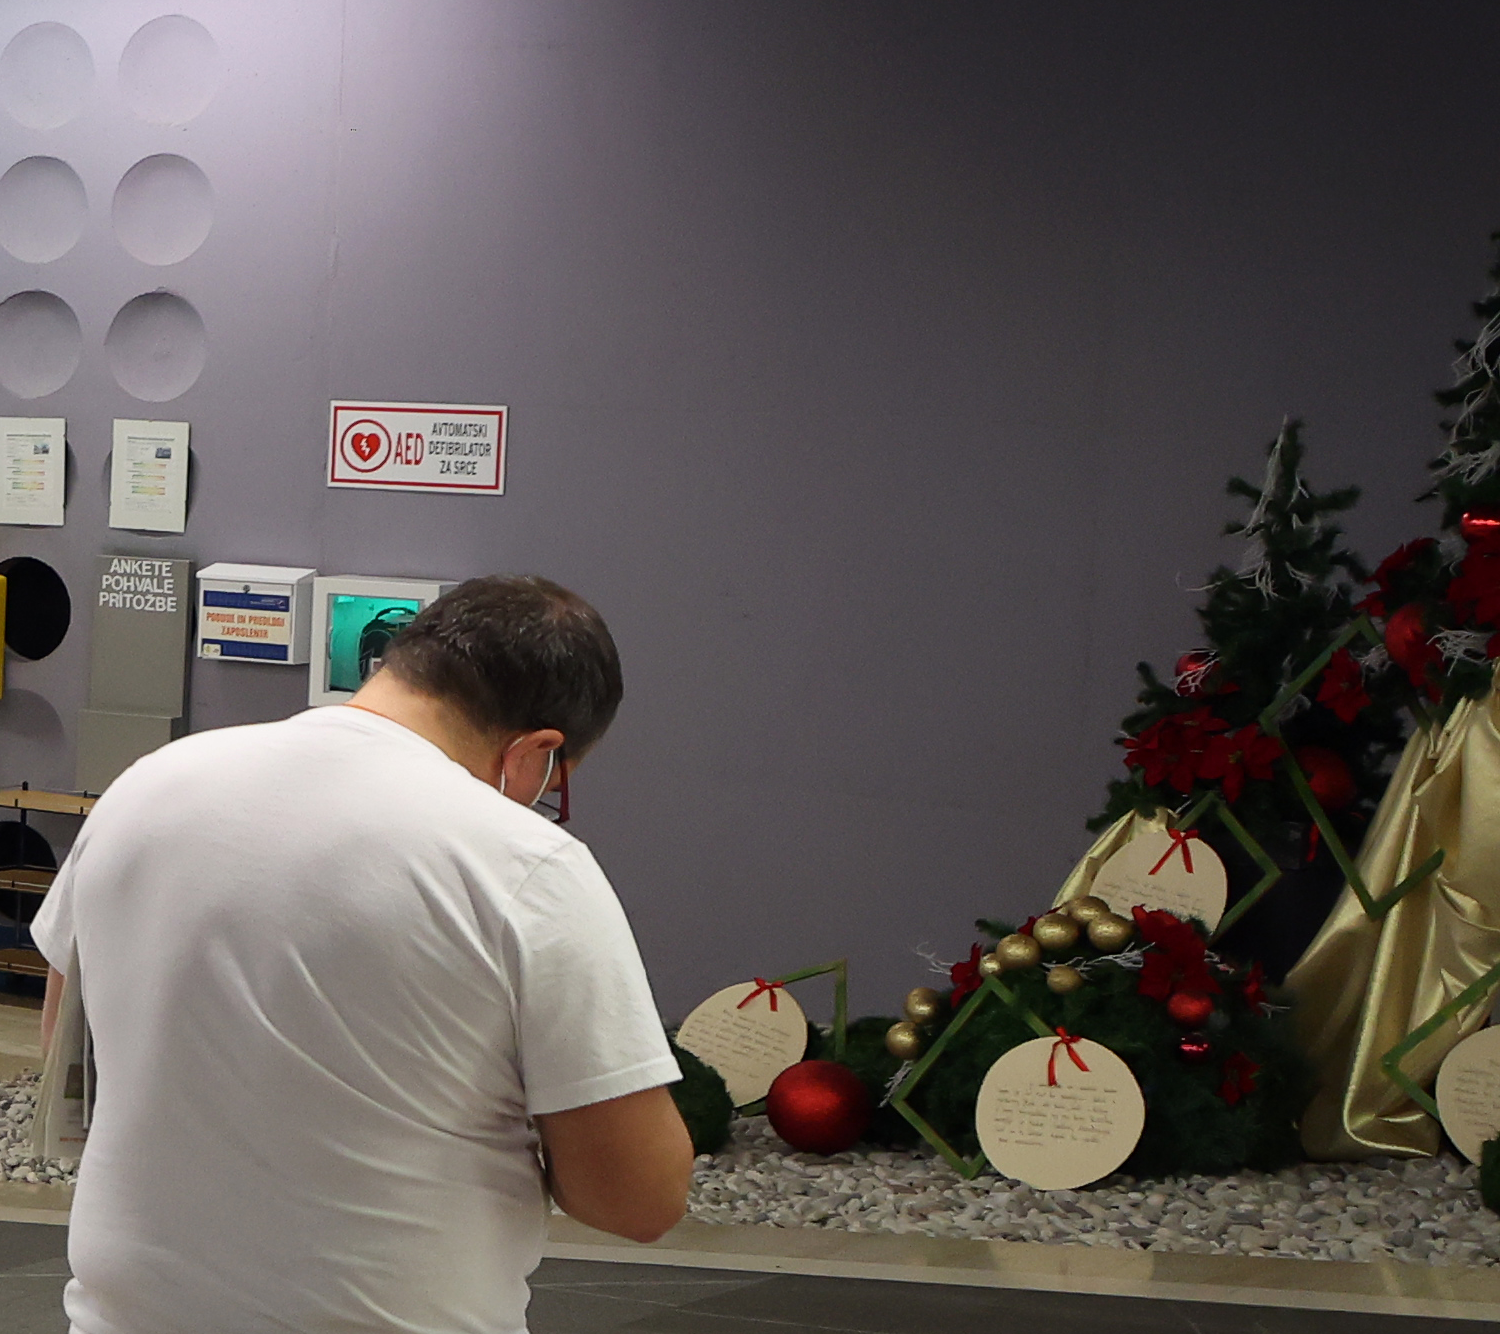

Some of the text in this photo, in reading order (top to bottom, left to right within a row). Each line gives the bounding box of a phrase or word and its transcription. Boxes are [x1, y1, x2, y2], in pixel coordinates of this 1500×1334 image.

[431, 422, 488, 438] AVTOMATSKI
[394, 432, 424, 465] AED
[428, 441, 492, 457] DEFIBRILATOR
[440, 460, 478, 475] ZA SRCE
[110, 558, 173, 577] ANKETE
[101, 574, 174, 594] POHVALE
